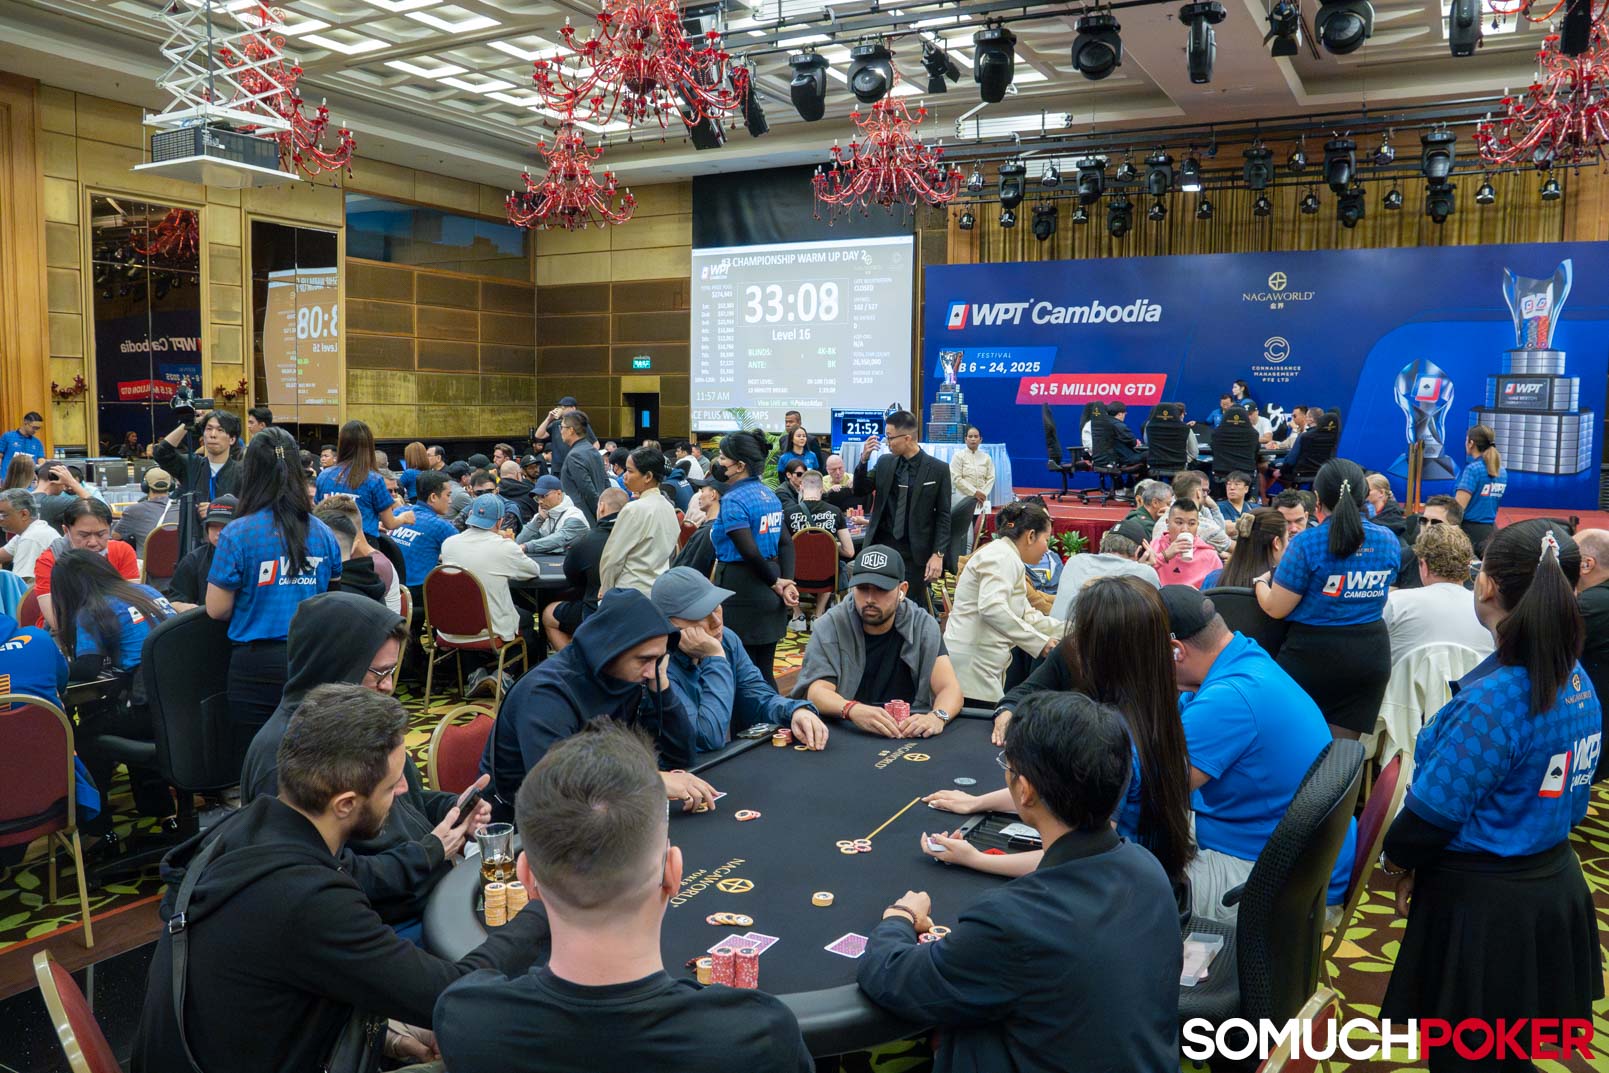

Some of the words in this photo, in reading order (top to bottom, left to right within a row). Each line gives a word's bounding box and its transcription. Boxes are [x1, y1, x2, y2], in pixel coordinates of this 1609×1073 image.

[732, 254, 795, 267] CHAMPIONSHIP
[798, 253, 826, 264] WARM
[828, 252, 840, 262] UP
[842, 250, 860, 261] DAY
[744, 282, 838, 324] 33:08
[1242, 292, 1313, 301] NAGAWORLD
[972, 302, 1030, 326] WPT
[1032, 299, 1162, 324] Cambodia
[772, 328, 797, 340] Level
[800, 328, 811, 340] 16
[969, 362, 976, 373] 6
[989, 362, 1007, 374] 24,
[1010, 361, 1041, 373] 2025
[1029, 382, 1058, 396] $1.5
[1061, 383, 1121, 396] MILLION
[1124, 383, 1156, 396] GTD
[1516, 383, 1543, 394] WPT
[696, 391, 716, 401] 11:57
[717, 391, 730, 400] AM
[704, 410, 721, 420] PLUS
[847, 423, 879, 435] 21:52
[392, 526, 421, 542] WPT
[280, 556, 324, 576] WT
[864, 554, 885, 567] DEUS
[1347, 570, 1392, 589] WPT
[1344, 590, 1384, 598] CAMBODIA
[670, 858, 746, 905] NAGAWORLD
